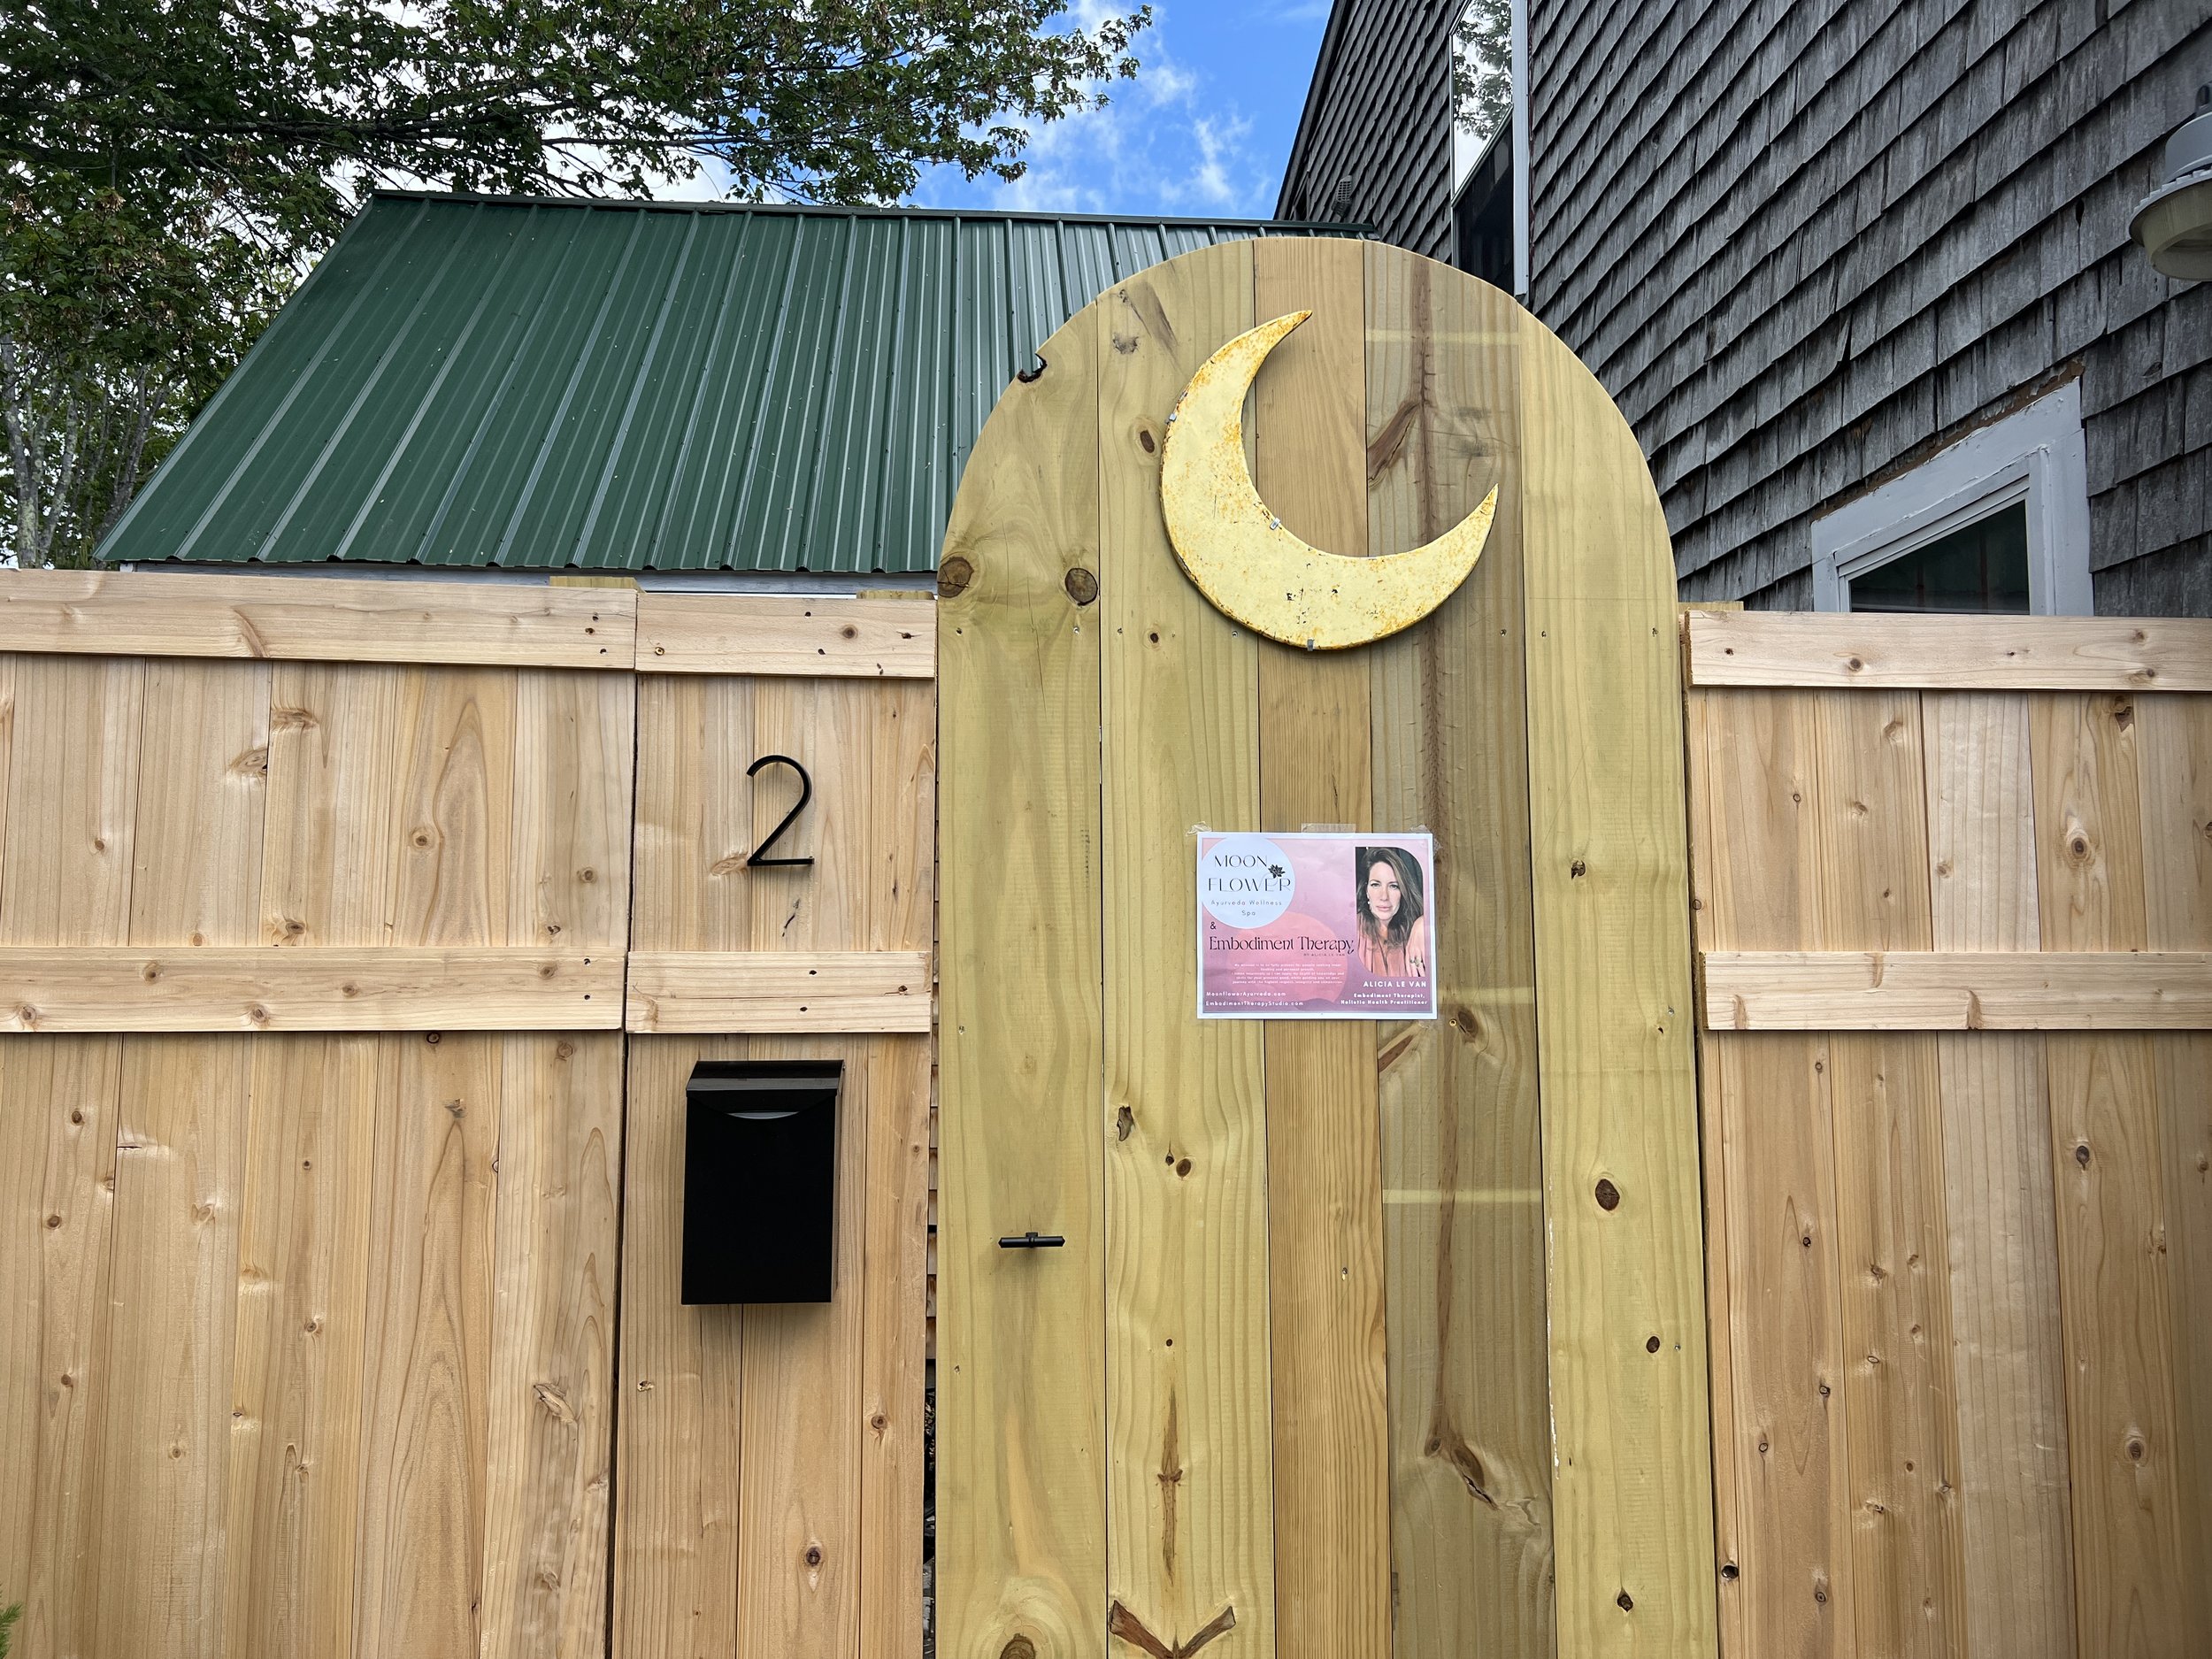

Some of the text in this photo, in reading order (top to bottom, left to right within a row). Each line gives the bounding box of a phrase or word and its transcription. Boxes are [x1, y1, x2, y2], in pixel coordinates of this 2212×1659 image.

[746, 755, 813, 866] 2
[1215, 855, 1267, 867] MOON
[1209, 877, 1291, 892] FLOWER
[1210, 921, 1217, 930] &
[1210, 936, 1355, 955] Embodiment Therapy
